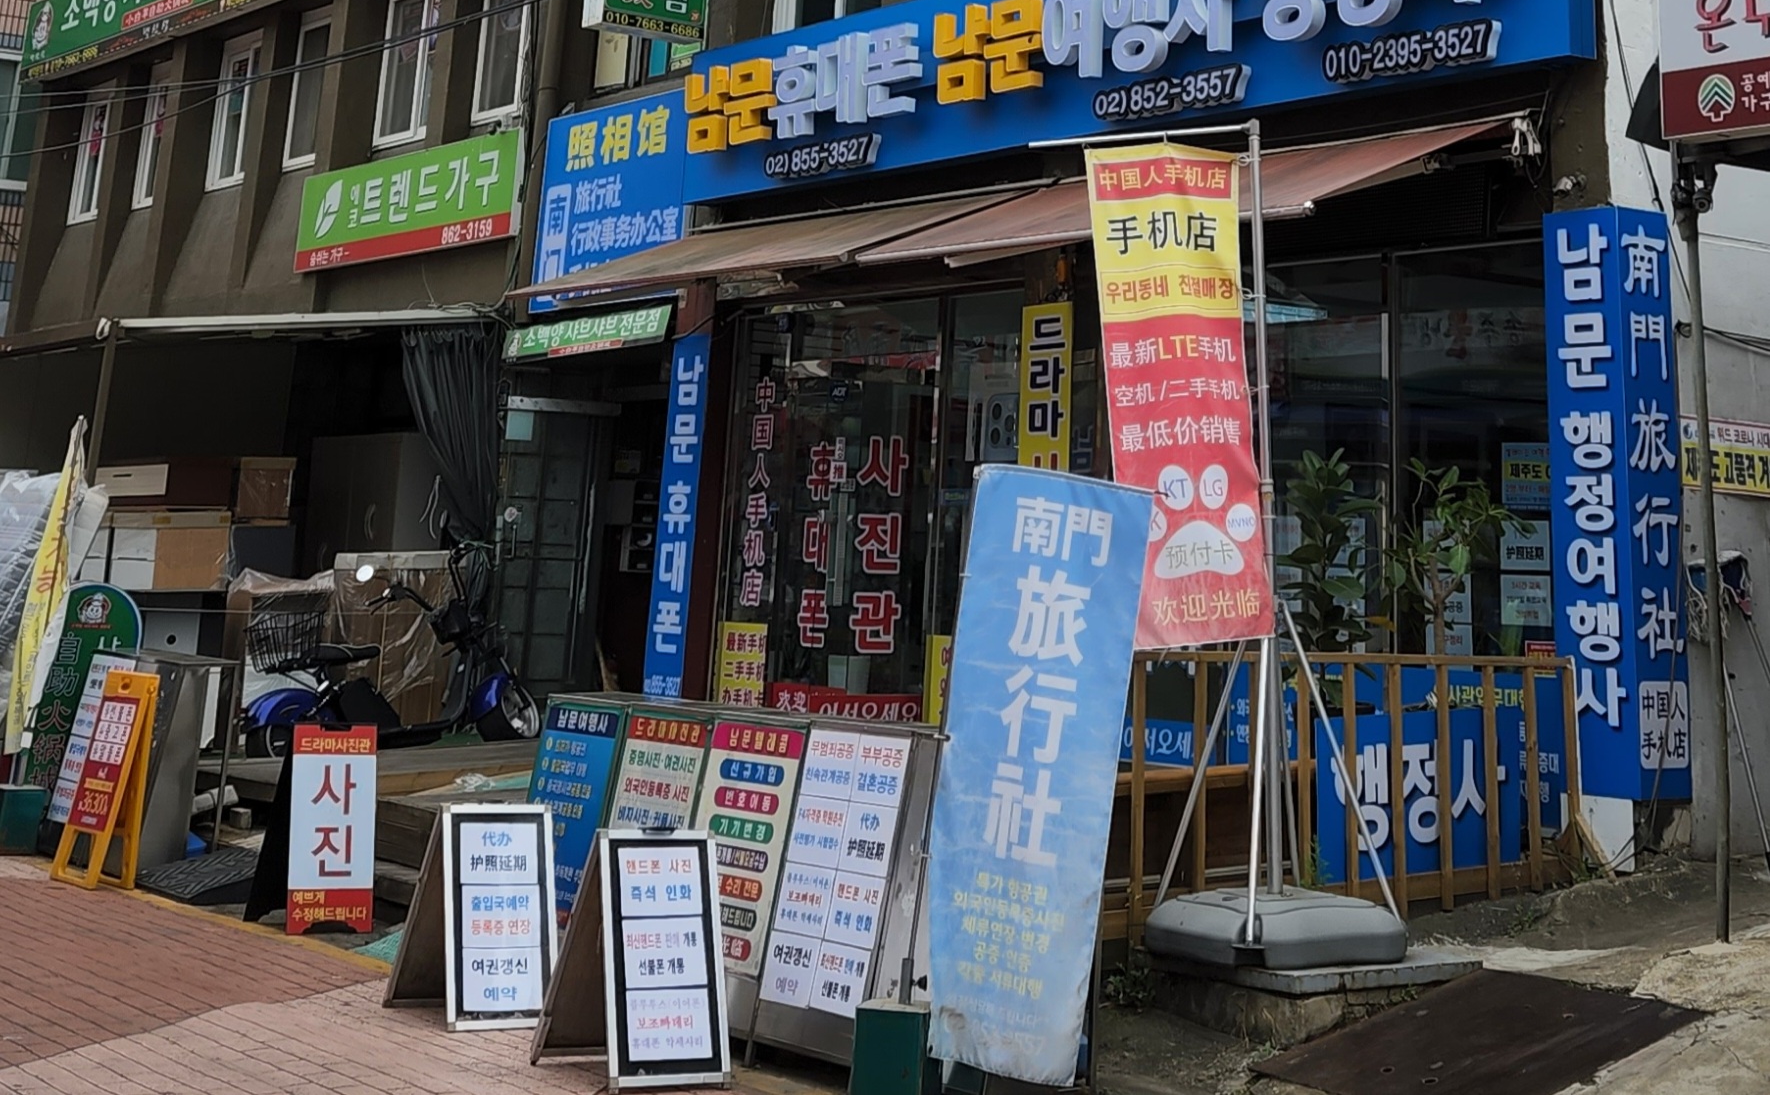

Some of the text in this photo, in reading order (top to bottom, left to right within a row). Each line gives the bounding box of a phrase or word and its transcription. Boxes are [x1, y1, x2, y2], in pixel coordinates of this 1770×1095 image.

[605, 10, 701, 39] 010-7663-6686
[1323, 22, 1489, 78] 010-2395-3527
[685, 57, 777, 154] 남문
[767, 22, 924, 140] 휴대폰
[565, 104, 671, 172] 照相馆
[1099, 163, 1227, 192] 中国人手机店
[573, 173, 623, 215] 旅行社
[441, 218, 493, 246] 862-3159
[570, 206, 680, 257] 行政事务办公室
[1106, 210, 1218, 256] 手机店
[1105, 274, 1234, 305] 우리동네 친절매장
[522, 308, 662, 348] 소백양 샤브샤브 전문점
[1109, 335, 1237, 369] 最新LTE手机
[1028, 315, 1066, 441] 드라마
[1119, 414, 1242, 454] 最低价销售
[1509, 462, 1543, 479] 제주도
[739, 376, 775, 607] 中国人手机店
[1162, 477, 1189, 500] KT
[1203, 479, 1224, 498] LG
[1012, 496, 1114, 567] 南門
[797, 441, 837, 649] 휴대폰
[850, 436, 909, 655] 사진관
[1165, 539, 1235, 570] 预付卡
[652, 480, 692, 655] 휴대폰
[1152, 587, 1261, 627] 欢迎光临
[982, 565, 1091, 868] 旅行社
[1641, 688, 1687, 721] 中国人
[557, 709, 610, 733] 남문여행사
[300, 737, 372, 754] 드라마사진관
[860, 744, 904, 769] 부부공증
[1641, 730, 1688, 761] 手机店
[729, 762, 778, 784] 신규가입
[856, 771, 899, 796] 결혼공증
[624, 776, 691, 804] 외국인등록증 사진
[724, 789, 772, 813] 번호이동
[311, 763, 357, 878] 사진
[718, 819, 768, 842] 기기변경
[859, 812, 881, 832] 代办
[481, 830, 512, 848] 代办
[846, 837, 886, 863] 护照延期
[470, 854, 528, 873] 护照延期
[626, 858, 692, 875] 핸드폰 사진
[292, 890, 325, 905] 예쁘게
[630, 884, 692, 903] 즉석 인화
[725, 876, 760, 899] 수리 전문
[863, 888, 879, 905] 사진
[291, 906, 368, 922] 수정해드립니다
[470, 894, 530, 913] 출입국예약
[470, 918, 532, 937] 등록증 연장
[834, 909, 873, 933] 즉석 인화
[472, 957, 529, 976] 여권갱신
[638, 957, 686, 977] 선불폰 개통
[773, 942, 813, 969] 여권갱신
[483, 985, 518, 1002] 예약
[775, 975, 799, 997] 예약
